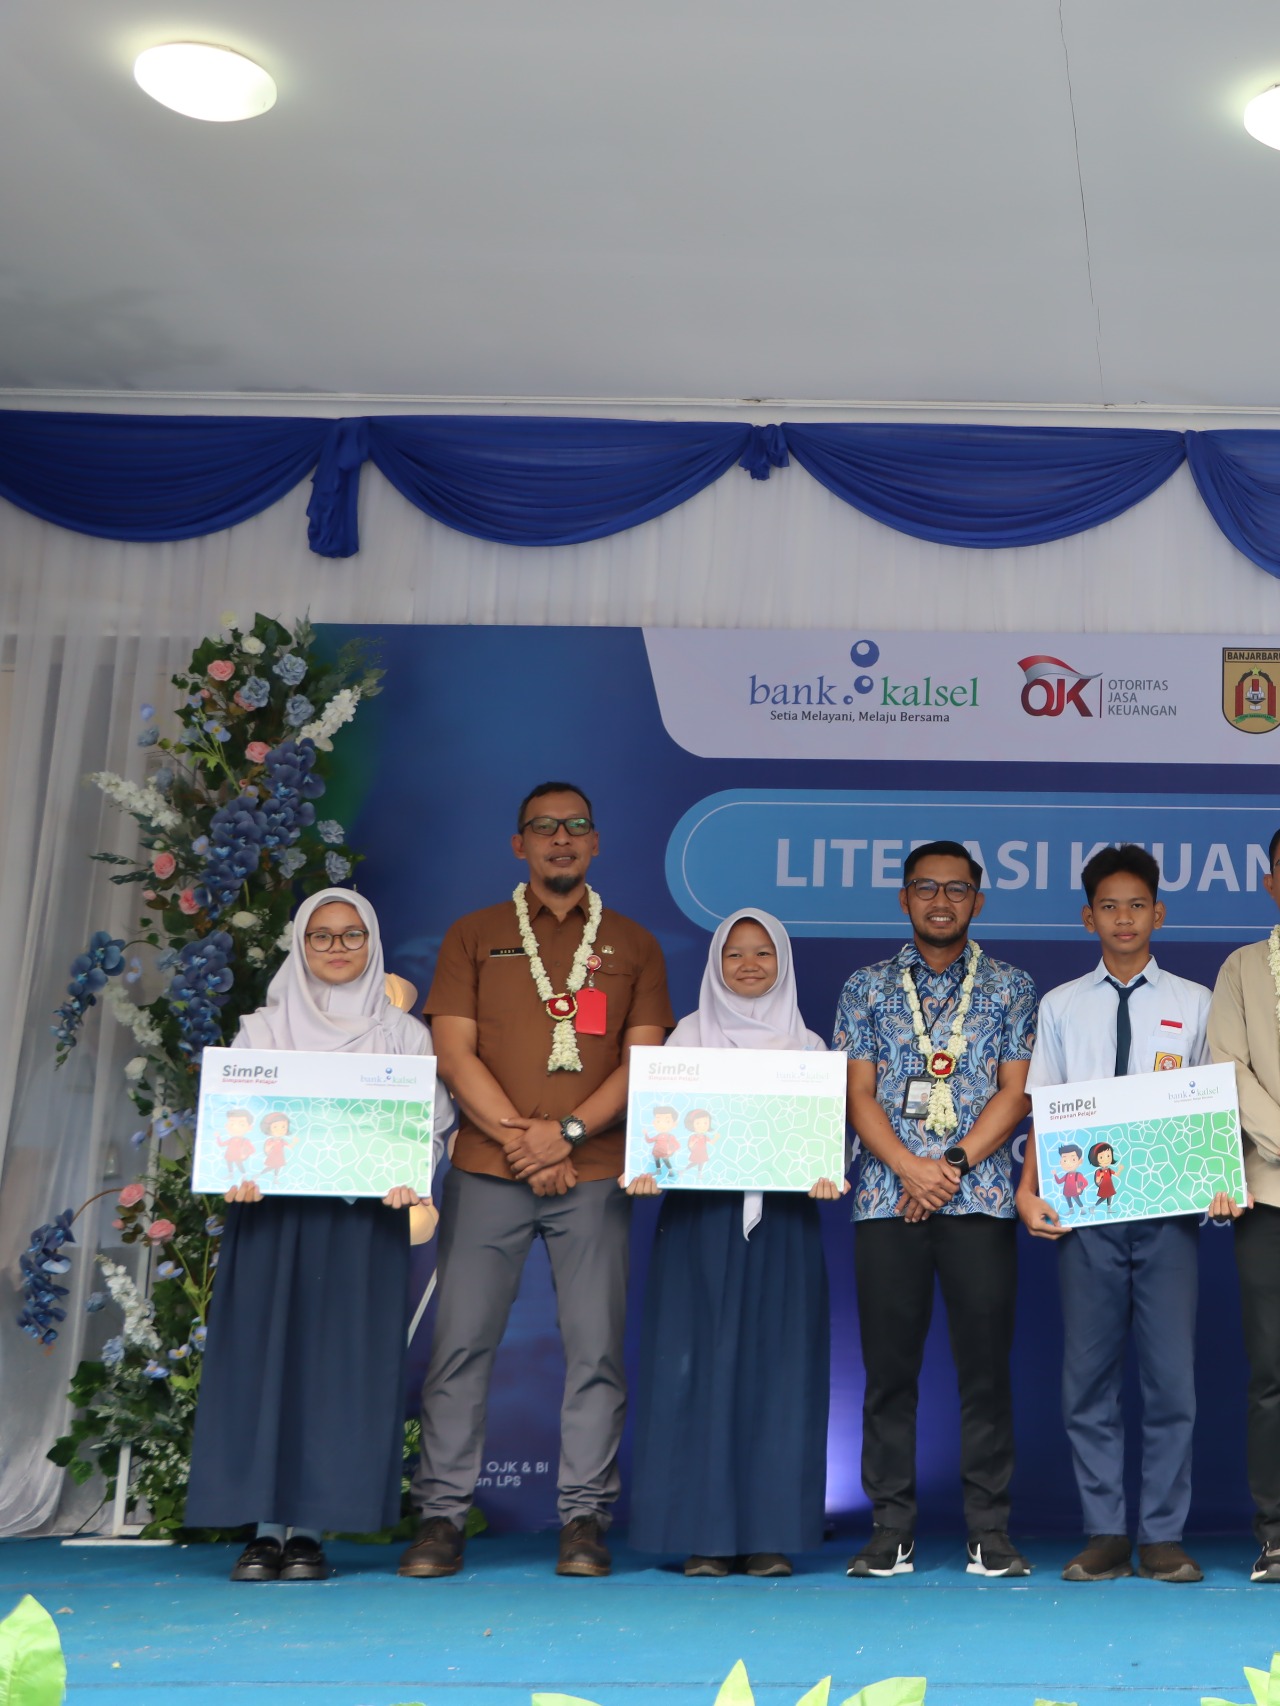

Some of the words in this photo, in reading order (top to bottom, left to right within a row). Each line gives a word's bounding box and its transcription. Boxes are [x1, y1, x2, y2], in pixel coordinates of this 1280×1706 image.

[750, 675, 836, 705] bank
[880, 676, 979, 706] kalsel
[1108, 679, 1168, 691] OTORITAS
[1021, 678, 1093, 717] OJK
[1108, 692, 1137, 703] JASA
[770, 710, 798, 721] Setia
[801, 710, 855, 723] Melayani,
[858, 711, 897, 723] Melaju
[900, 711, 950, 722] Bersama
[1108, 705, 1177, 716] KEUANGAN
[776, 838, 1049, 890] LITEASI
[222, 1064, 278, 1079] SimPel
[648, 1062, 700, 1076] SimPel
[1049, 1097, 1096, 1114] SimPel
[486, 1461, 518, 1473] OJK
[521, 1461, 531, 1473] &
[536, 1461, 549, 1473] BI
[497, 1475, 522, 1486] LPS
